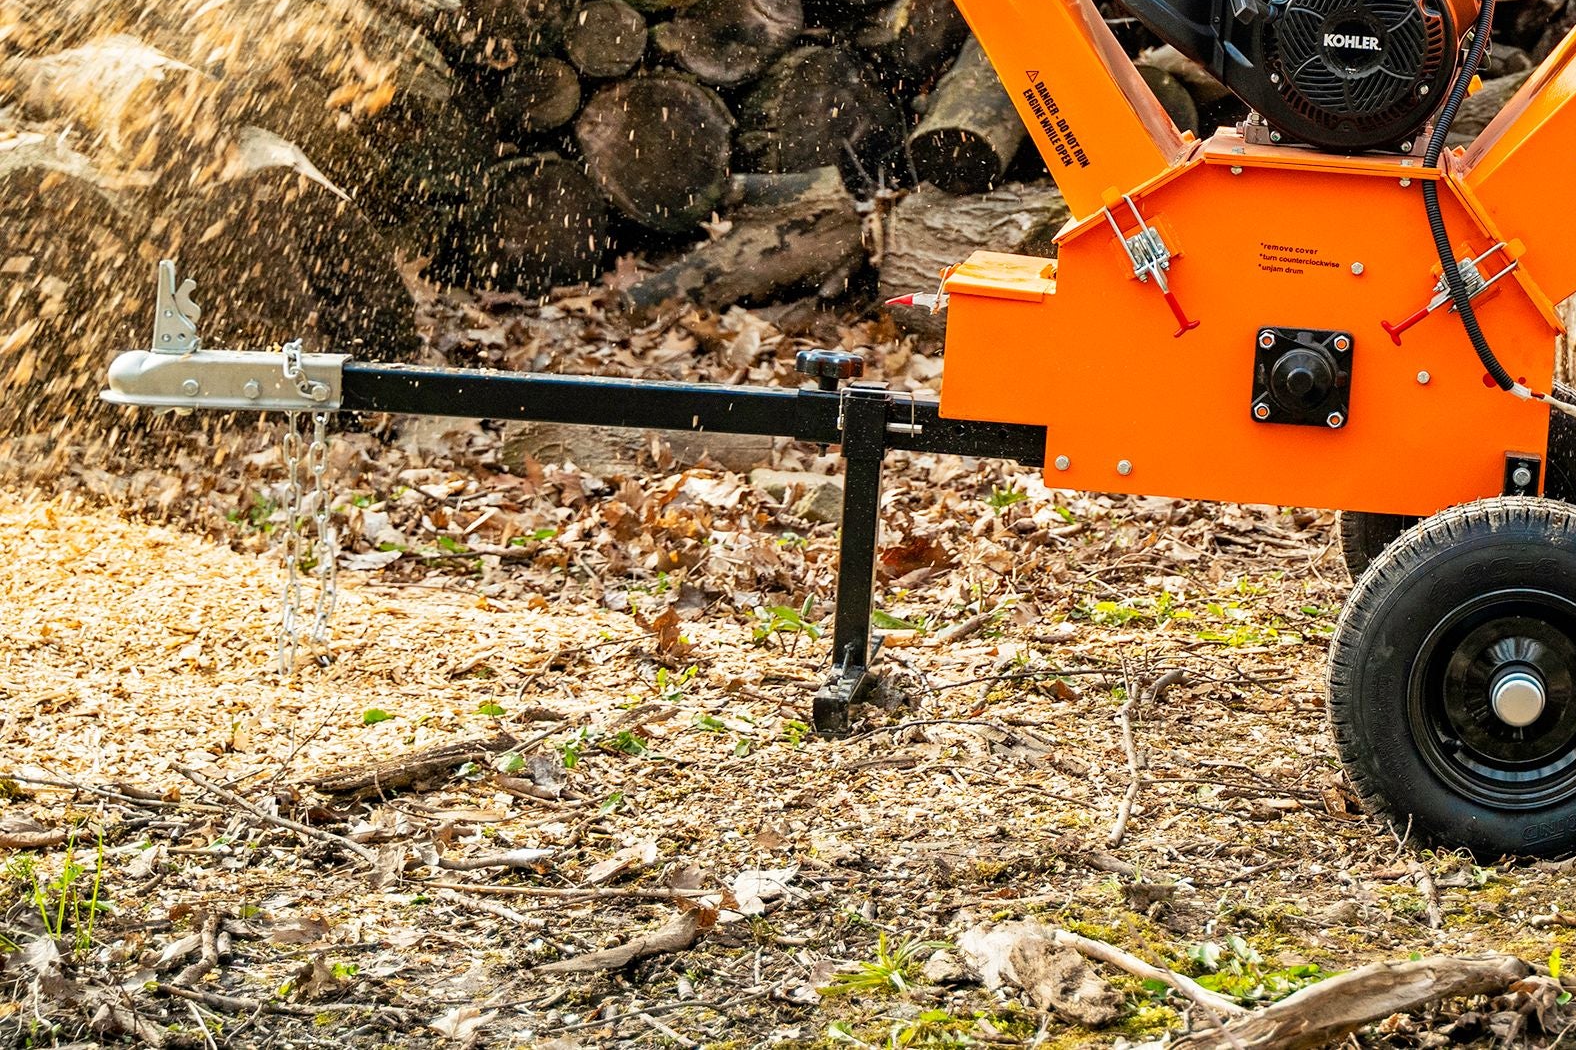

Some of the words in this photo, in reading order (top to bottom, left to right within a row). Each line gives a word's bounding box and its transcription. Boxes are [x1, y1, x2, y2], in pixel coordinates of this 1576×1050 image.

[1022, 88, 1046, 120] ENGINE
[1039, 117, 1062, 146] WHILE
[1054, 143, 1074, 168] OPEN
[1034, 81, 1060, 116] DANGER
[1055, 118, 1070, 133] DO
[1063, 131, 1081, 150] NOT
[1073, 148, 1091, 169] RUN
[1294, 247, 1318, 255] cover
[1278, 255, 1340, 269] counterclockwise
[1284, 266, 1304, 275] drum
